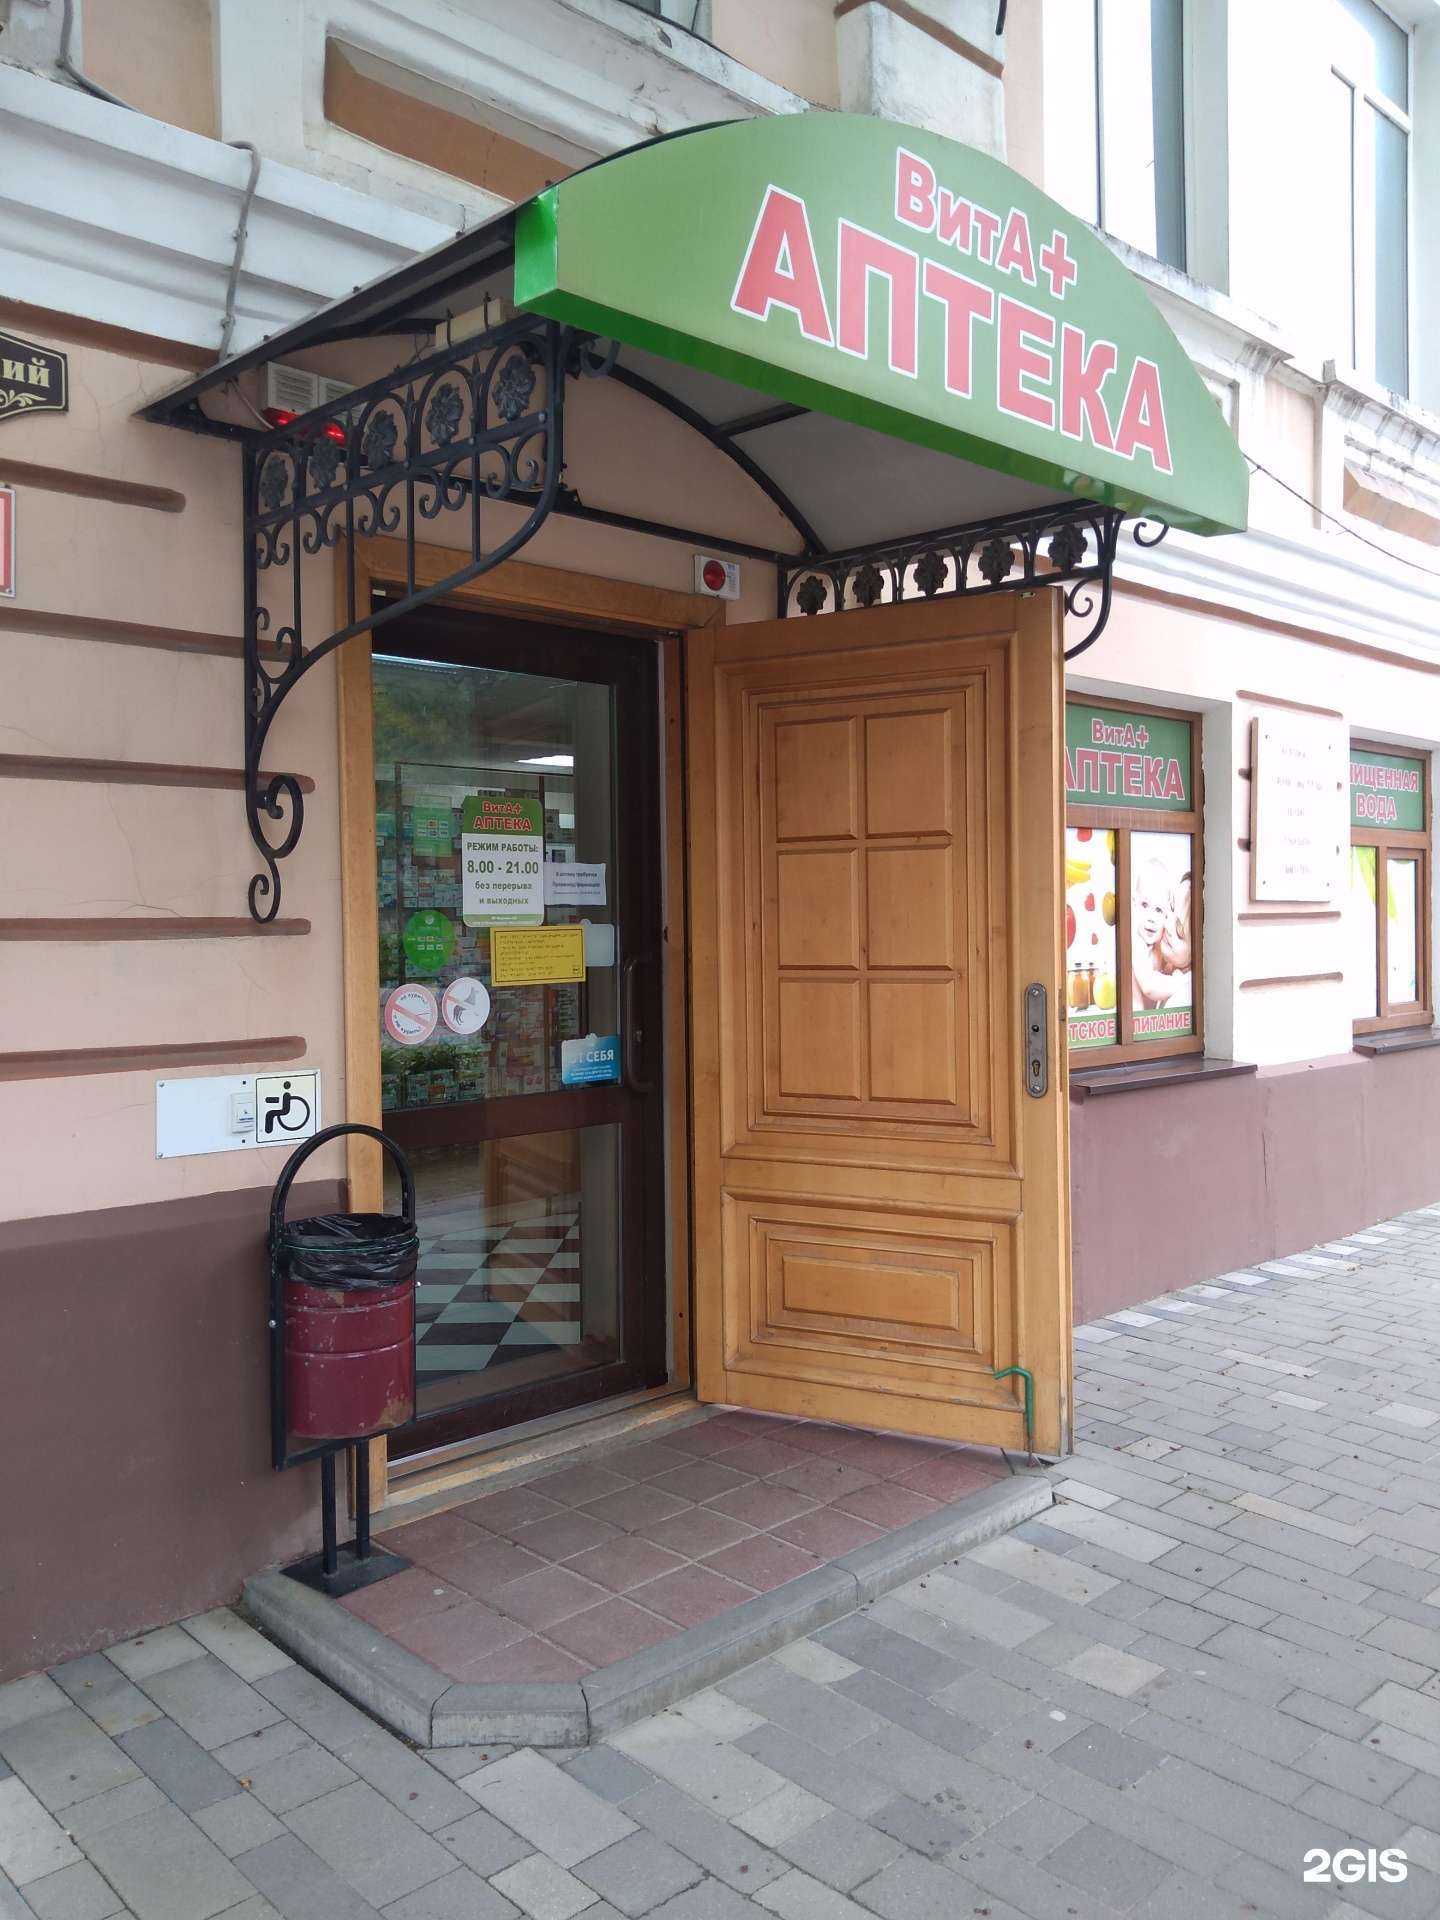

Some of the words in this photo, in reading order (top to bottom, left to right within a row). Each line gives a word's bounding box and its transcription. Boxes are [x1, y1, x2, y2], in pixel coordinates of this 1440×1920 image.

[731, 184, 1174, 475] АПТЕКА
[1, 357, 50, 388] ий
[1350, 762, 1419, 792] ИЩЕННАЯ
[1356, 793, 1397, 824] ВОДА
[474, 815, 533, 832] АПТЕКА
[467, 842, 499, 852] РЕЖИМ
[501, 843, 539, 853] РАБОТЫ:
[467, 860, 495, 873] 8.00
[505, 861, 539, 874] 21.00
[475, 881, 490, 890] без
[492, 883, 533, 892] перерыва
[1068, 1019, 1116, 1041] ТСКОЕ
[586, 1049, 614, 1063] СЕБЯ
